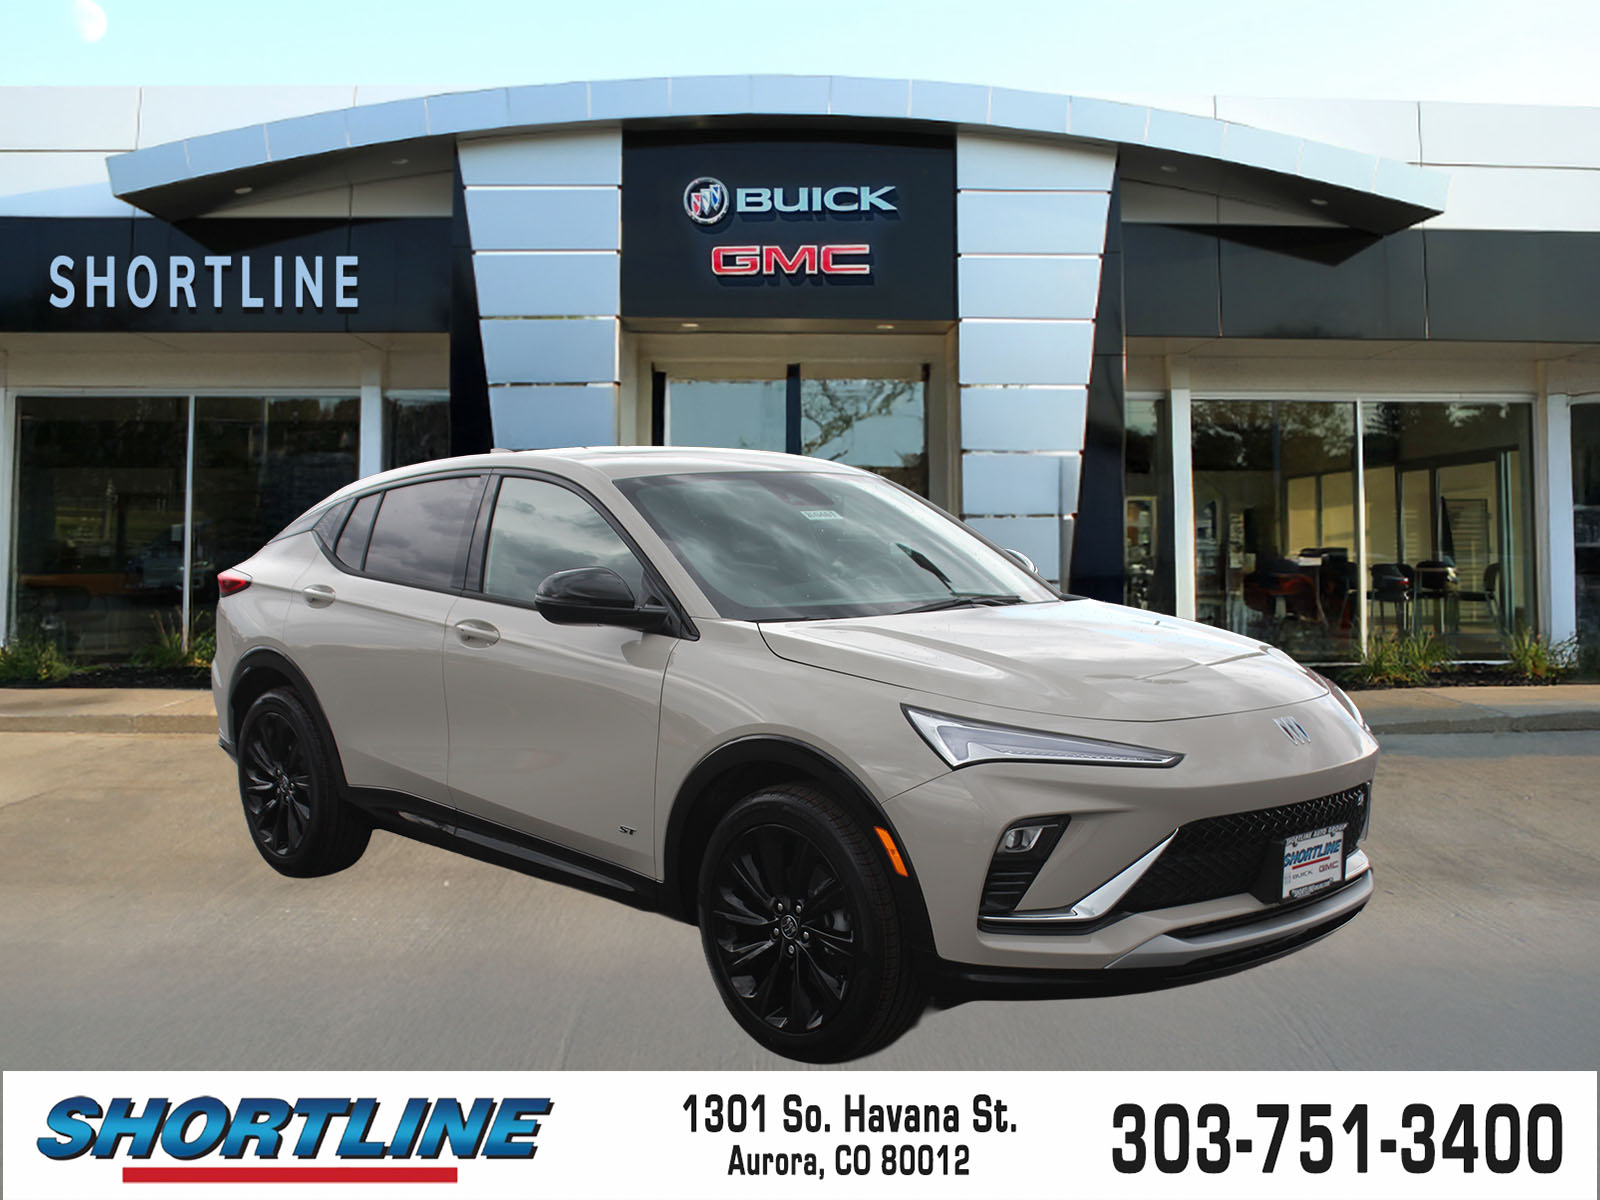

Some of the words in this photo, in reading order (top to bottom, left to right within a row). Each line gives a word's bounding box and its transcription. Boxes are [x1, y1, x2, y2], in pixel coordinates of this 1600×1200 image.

[736, 185, 898, 213] BUICK
[711, 244, 870, 276] GMC
[49, 255, 359, 309] SHORTLINE
[618, 825, 637, 836] ST
[1283, 839, 1343, 867] SHORTLINE
[1318, 860, 1338, 873] GMC
[1292, 870, 1313, 880] BUICK
